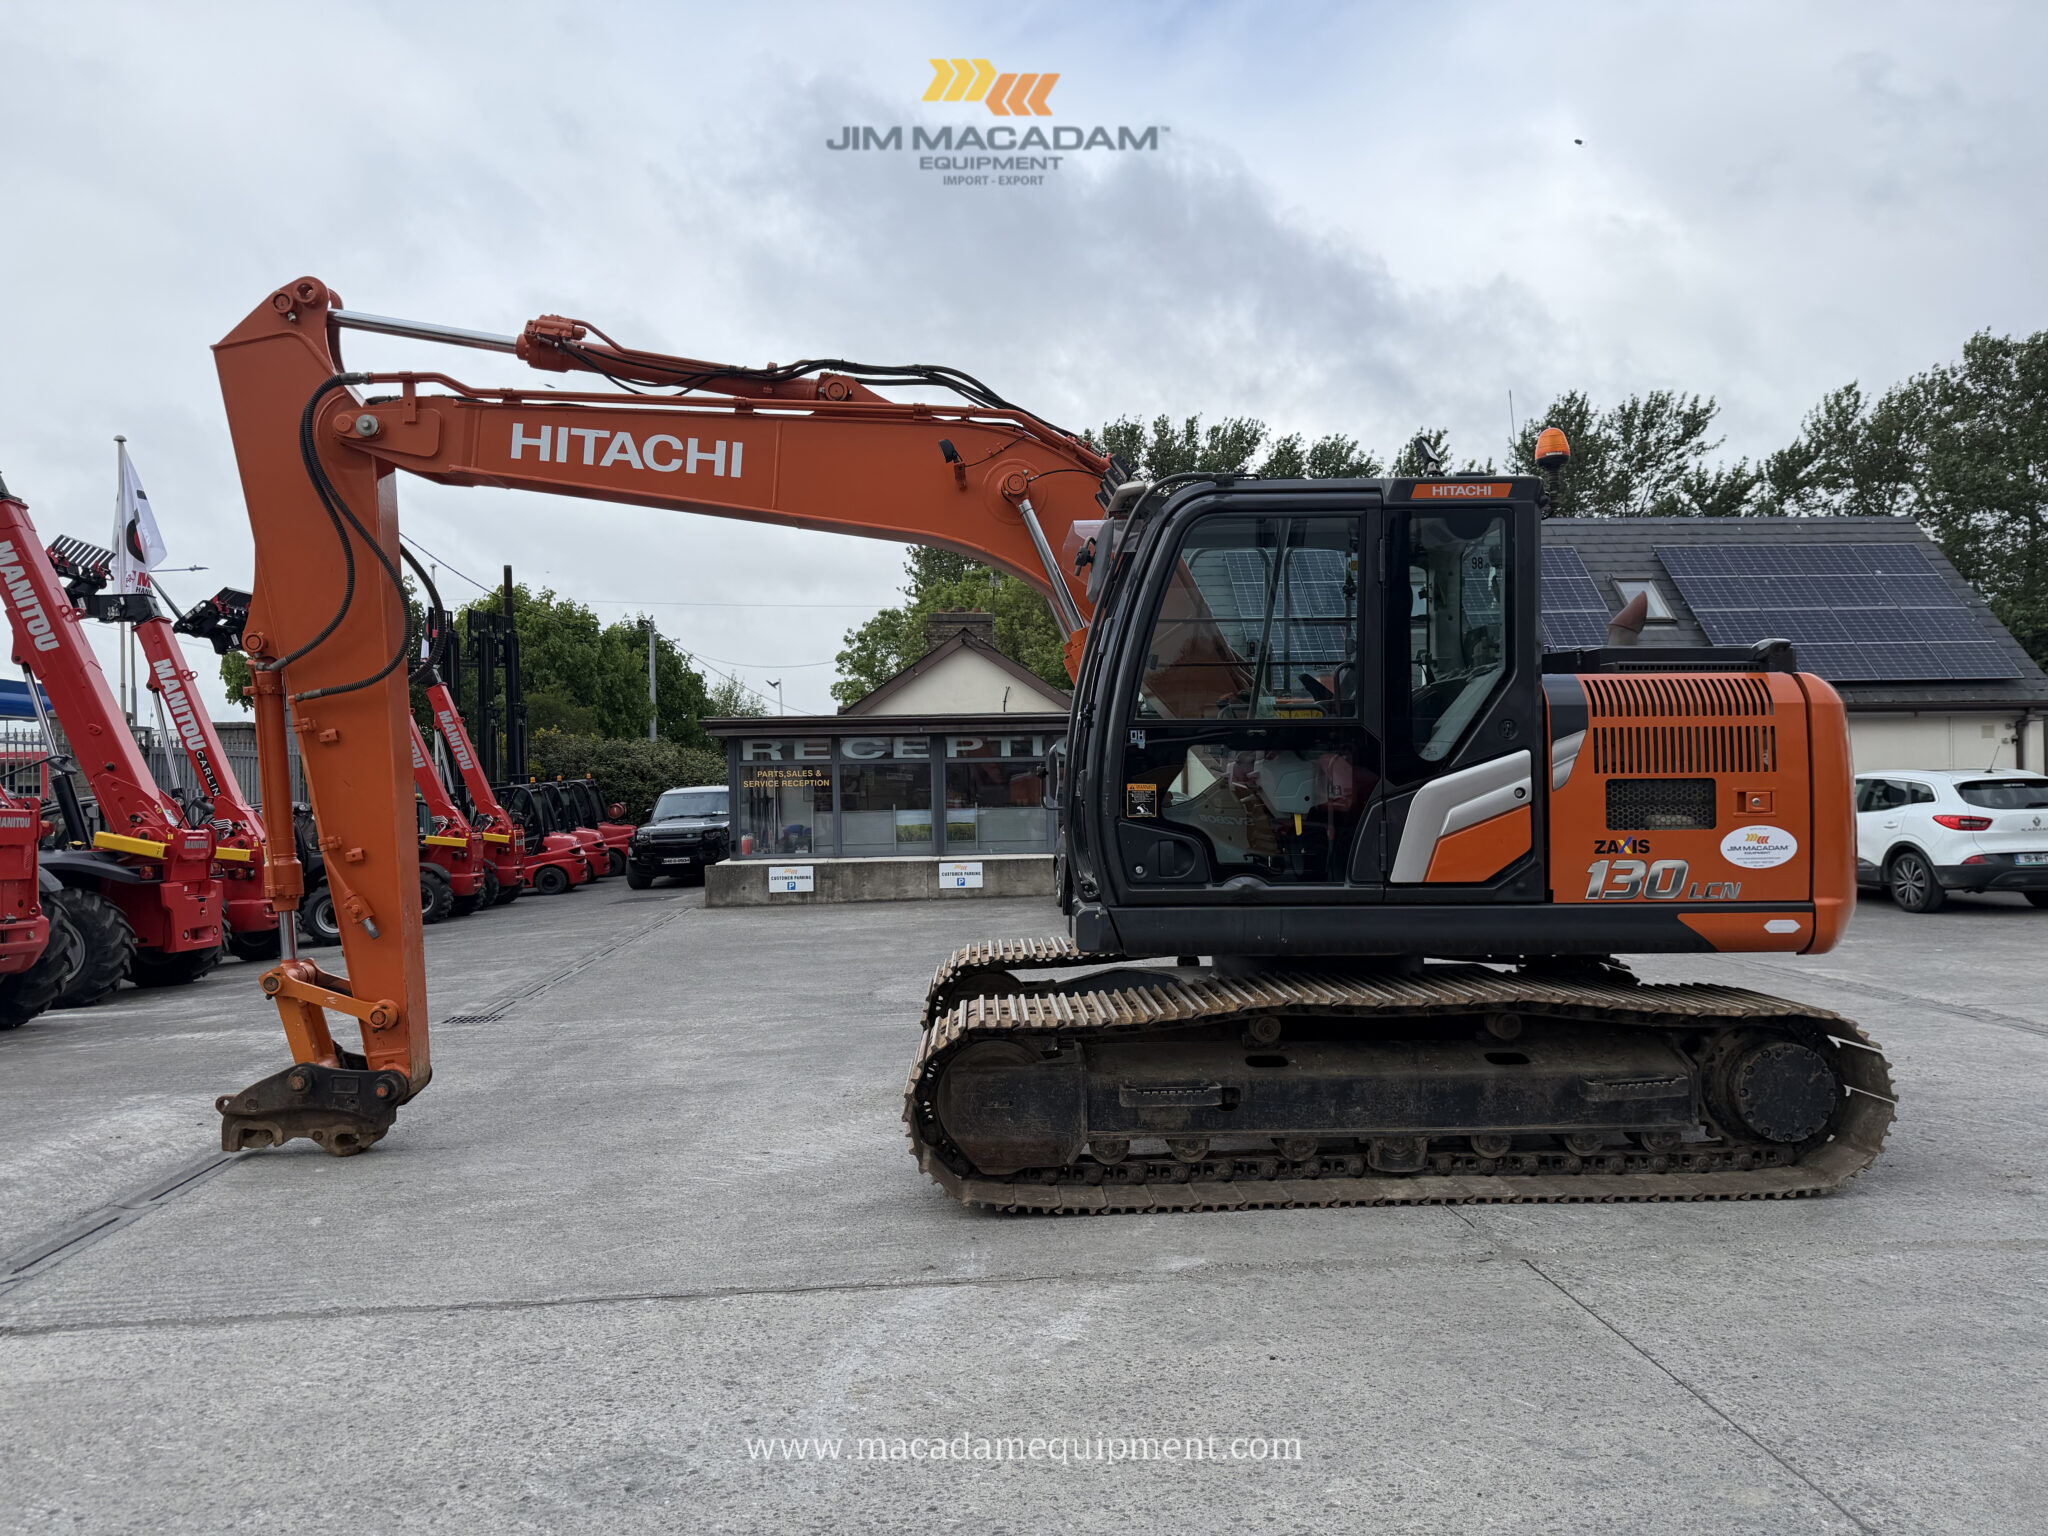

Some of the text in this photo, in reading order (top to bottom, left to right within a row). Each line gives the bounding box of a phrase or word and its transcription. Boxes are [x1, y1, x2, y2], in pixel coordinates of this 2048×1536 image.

[510, 422, 743, 478] HITACHI
[1432, 486, 1491, 496] HITACHI
[1471, 557, 1483, 570] 98
[0, 540, 60, 651] MANITOU
[153, 658, 206, 751] MANITOU
[438, 710, 473, 770] MANITOU
[743, 734, 1067, 760] RECEPTI
[196, 751, 220, 796] CARLIN
[743, 779, 830, 788] SERVICE RECEPTION
[0, 817, 30, 828] ANITOU
[1594, 836, 1650, 854] ZAXIS
[1585, 859, 1741, 900] 130 LCN
